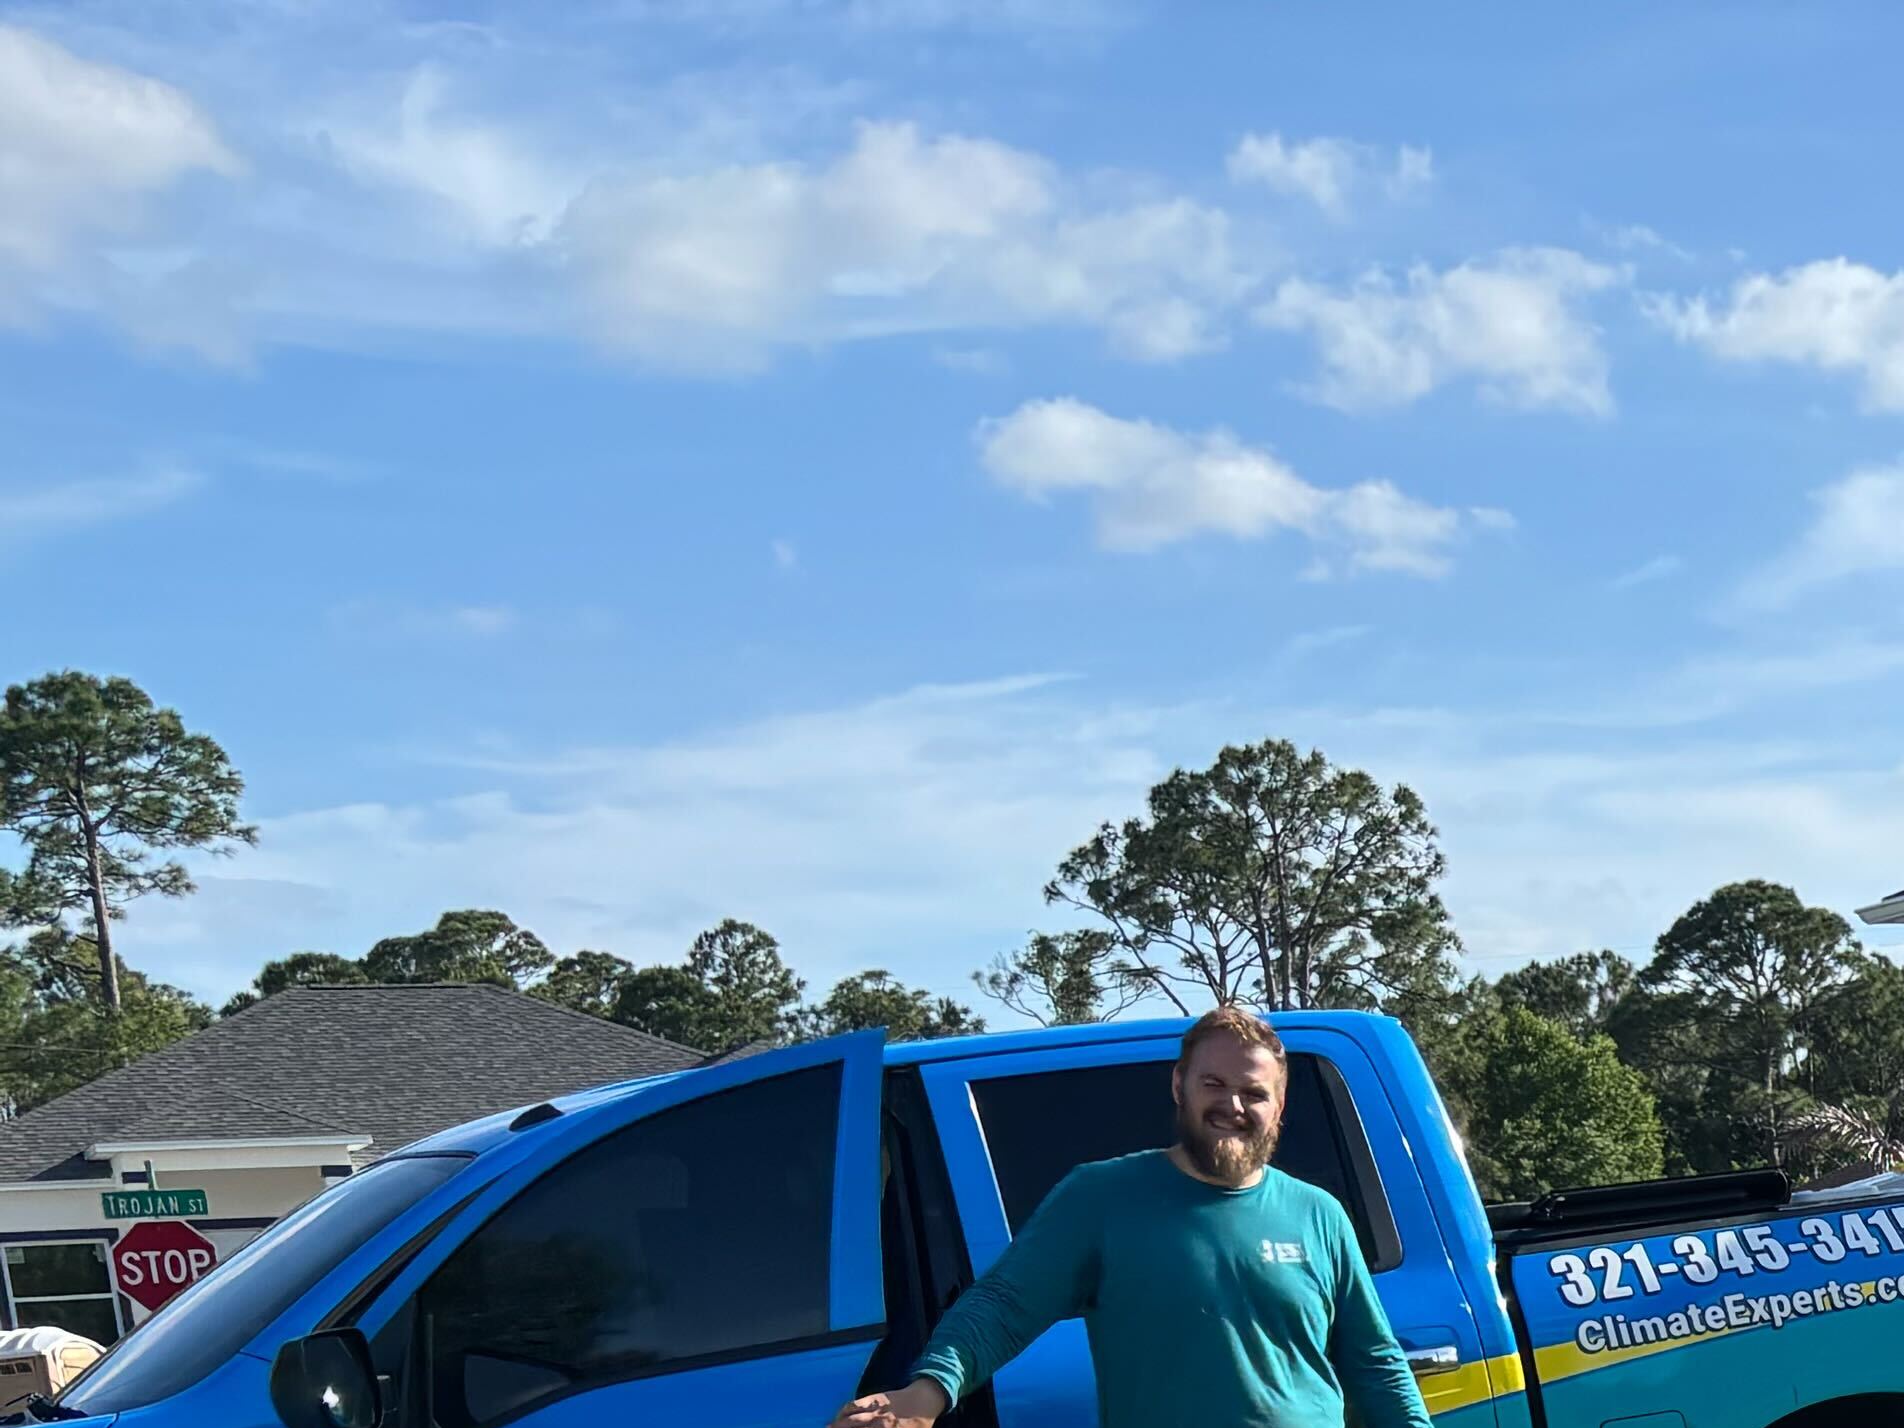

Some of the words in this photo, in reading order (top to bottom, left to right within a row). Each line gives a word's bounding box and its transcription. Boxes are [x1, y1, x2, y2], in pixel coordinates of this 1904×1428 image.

[104, 1195, 180, 1216] TROJAN
[188, 1199, 204, 1213] ST
[121, 1249, 211, 1286] STOP
